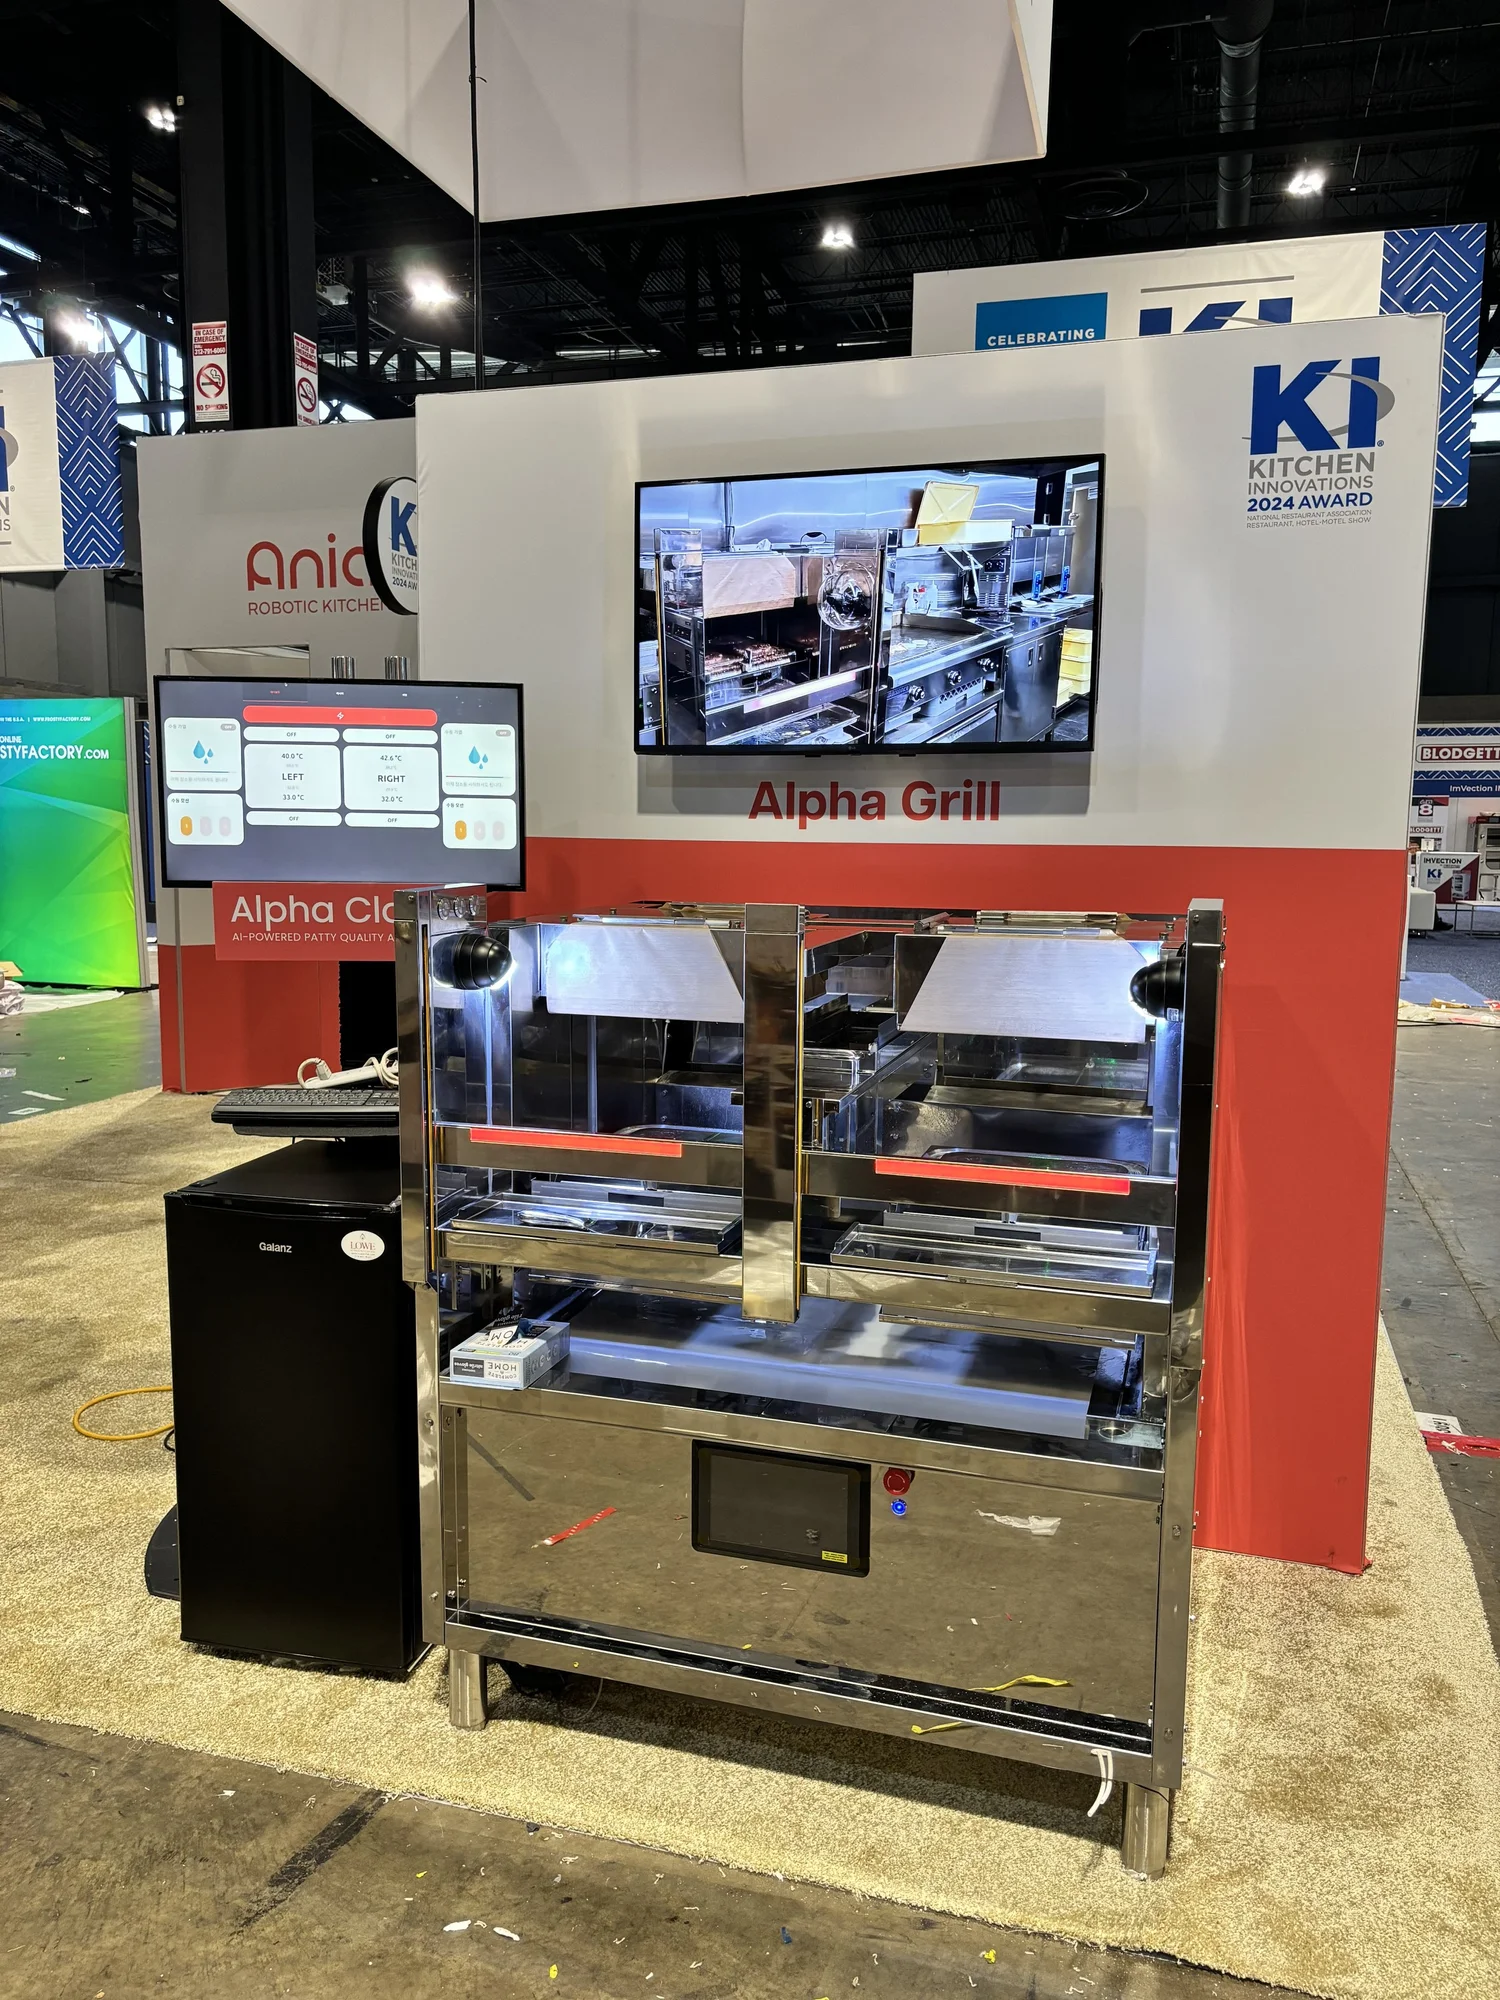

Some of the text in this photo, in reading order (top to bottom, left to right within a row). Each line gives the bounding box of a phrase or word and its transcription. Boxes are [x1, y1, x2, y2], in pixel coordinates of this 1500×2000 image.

[987, 328, 1095, 347] CELEBRATING
[205, 403, 228, 411] SKING
[1250, 356, 1380, 455] KI
[1249, 452, 1375, 479] KITCHEN
[1248, 475, 1373, 495] INNOVATIONS
[1247, 492, 1373, 512] 2024 AWARD
[1282, 512, 1325, 520] RESTAURANT
[1326, 509, 1372, 517] ASSOCIATION
[391, 496, 417, 556] K
[1247, 521, 1294, 529] RESTAURANT,
[1296, 518, 1346, 526] HOTEL-MOTEL
[391, 552, 417, 571] KITCH
[392, 568, 417, 580] INNOVATI
[392, 577, 407, 588] 2024
[248, 600, 318, 615] ROBOTIC
[0, 745, 109, 759] STYFACTORY.COM
[1422, 747, 1500, 759] BLODGETT
[282, 773, 304, 781] LEFT
[377, 775, 405, 783] RIGHT
[748, 779, 1000, 830] Alpha Grill
[1419, 804, 1433, 815] 8
[231, 895, 394, 931] Alpha Clo
[232, 932, 301, 942] AI-POWERED
[304, 933, 337, 942] PATTY
[340, 933, 384, 943] QUALITY
[259, 1242, 292, 1253] Galanz
[350, 1241, 376, 1251] LOWE
[488, 1361, 517, 1371] HOME
[488, 1371, 517, 1380] COMPLETE
